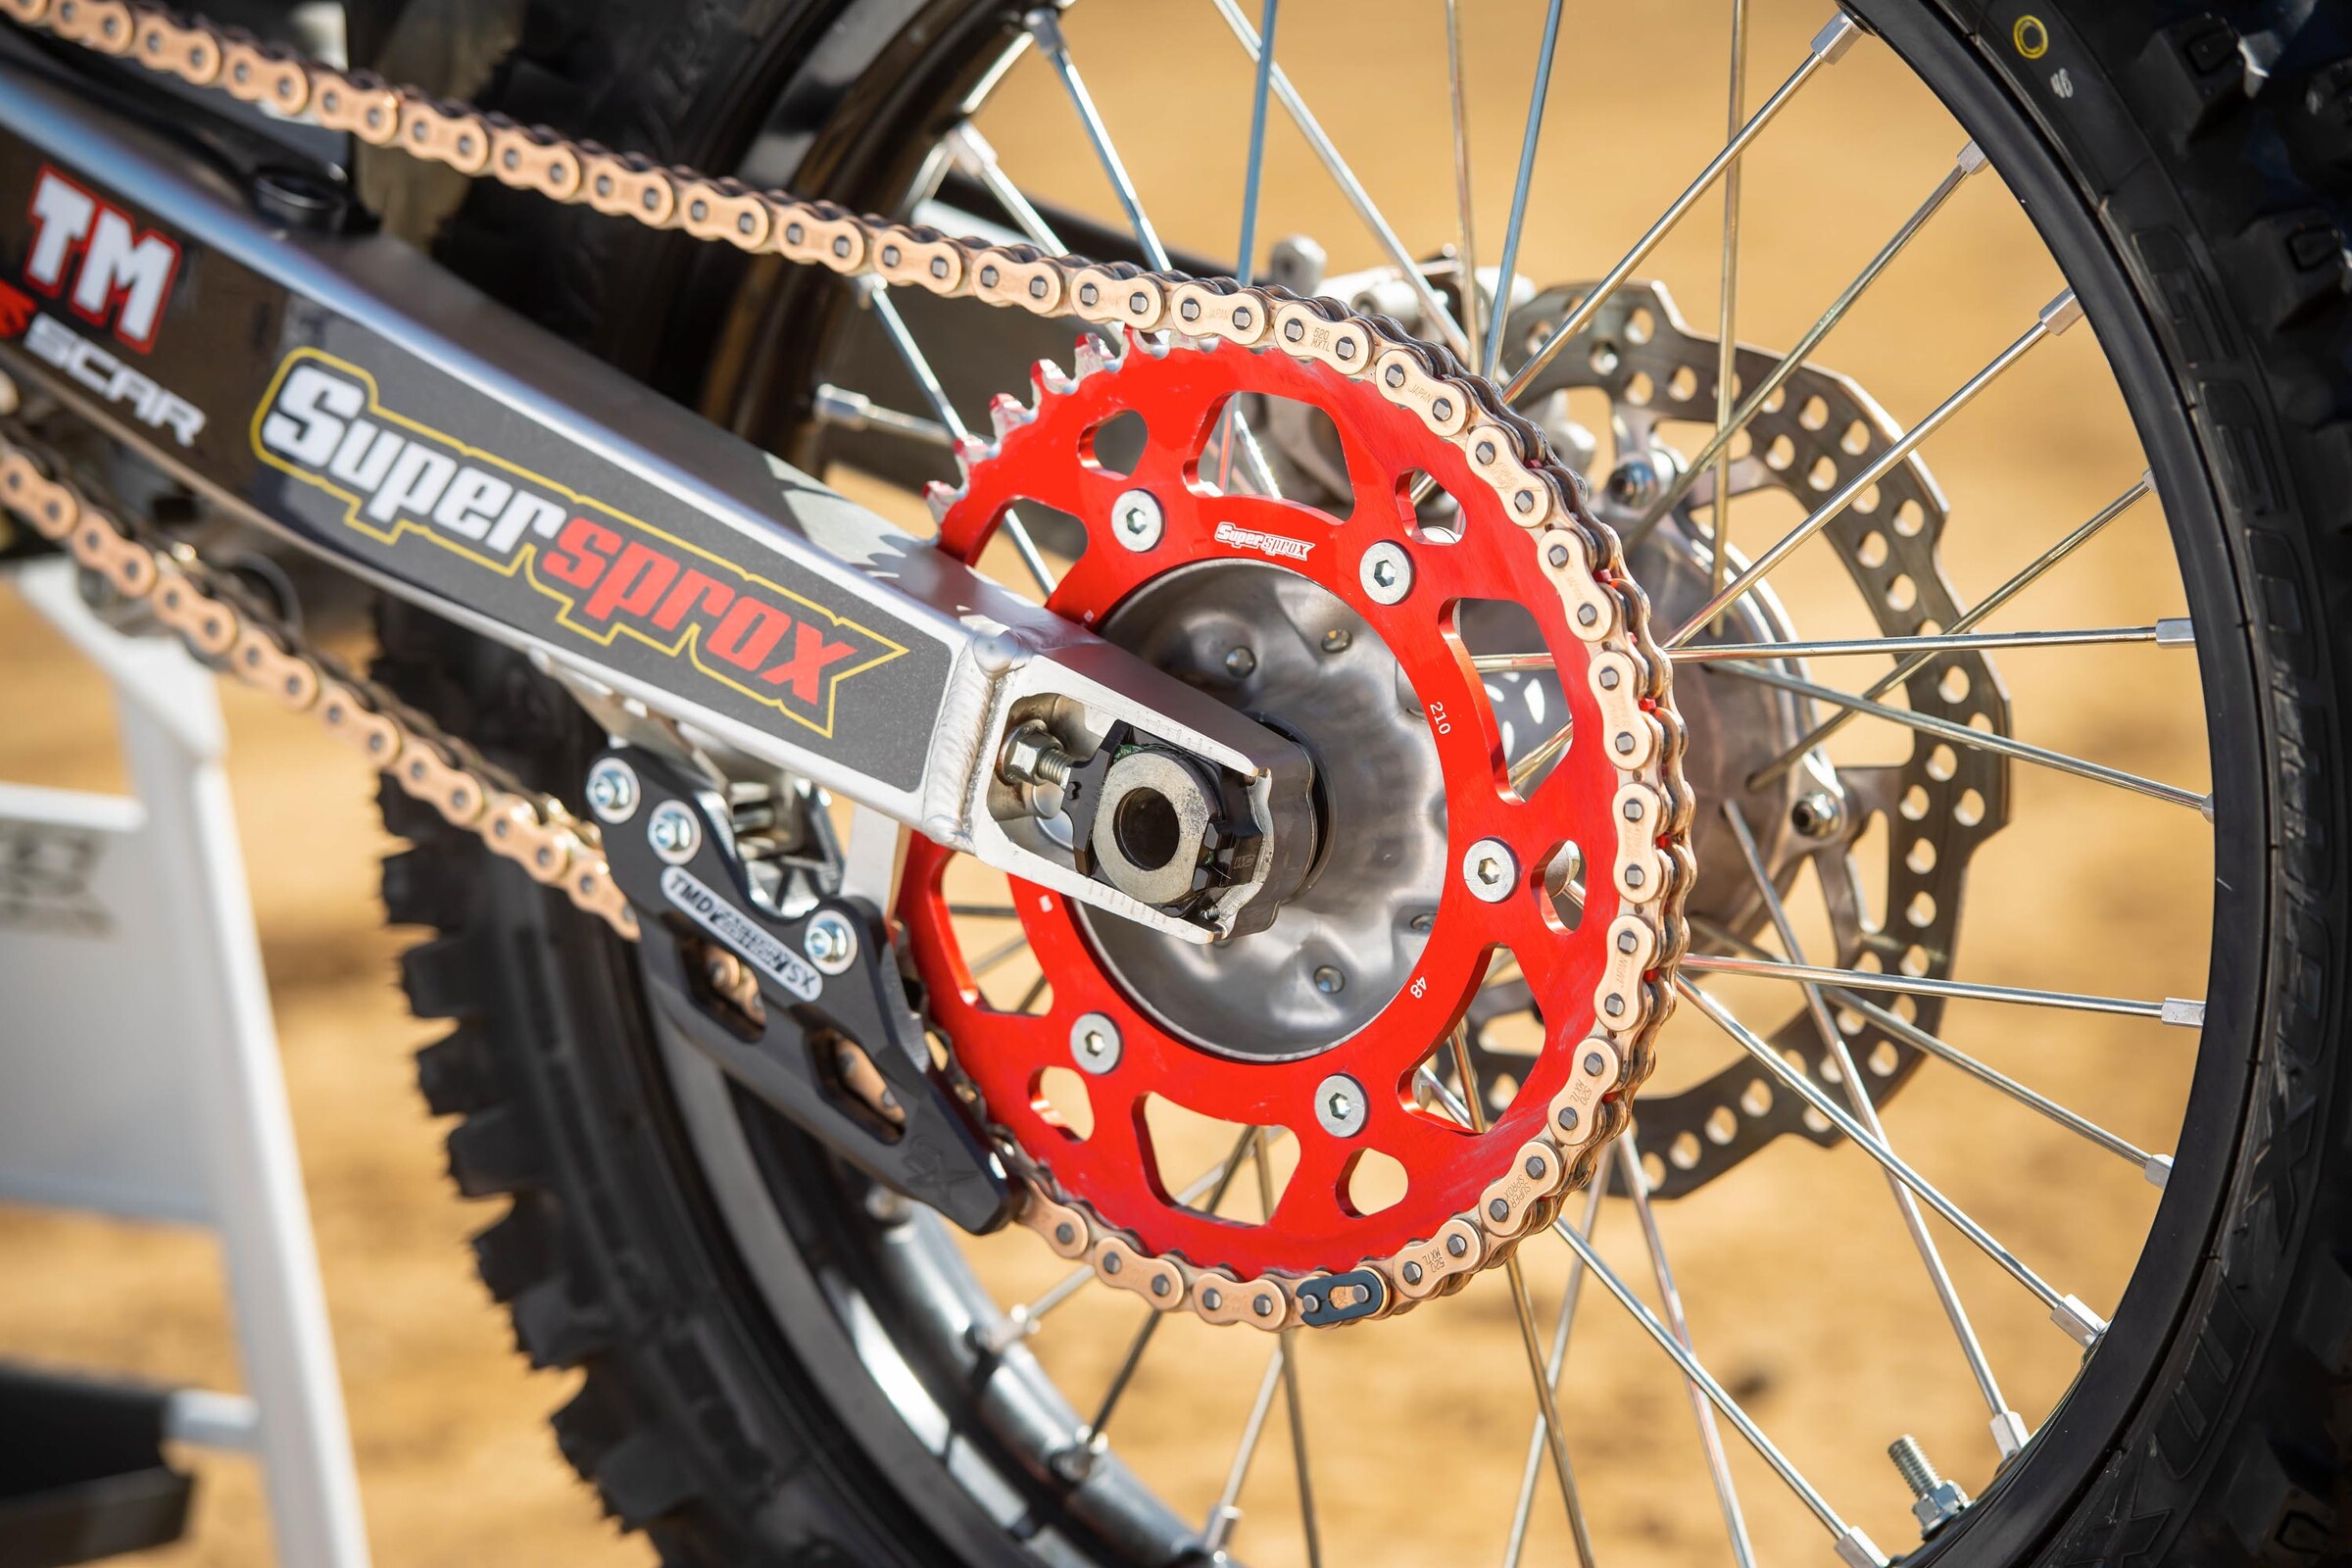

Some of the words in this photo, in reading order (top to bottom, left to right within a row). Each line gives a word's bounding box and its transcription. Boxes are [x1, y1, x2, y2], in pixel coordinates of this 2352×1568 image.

[26, 169, 176, 343] TM
[1312, 326, 1331, 340] 520
[1310, 337, 1331, 353] MXTL
[23, 311, 207, 448] SCAR
[1407, 383, 1432, 404] JAPAN
[1430, 701, 1451, 735] 210
[670, 874, 713, 913] TMD
[787, 962, 817, 995] SX
[1410, 976, 1427, 999] 48
[1569, 1078, 1584, 1102] MXTL
[1582, 1088, 1593, 1105] 520
[1503, 1173, 1525, 1200] SPROX
[1511, 1182, 1532, 1209] SUPER
[1421, 1247, 1441, 1266] MXTL
[1431, 1256, 1446, 1273] 520
